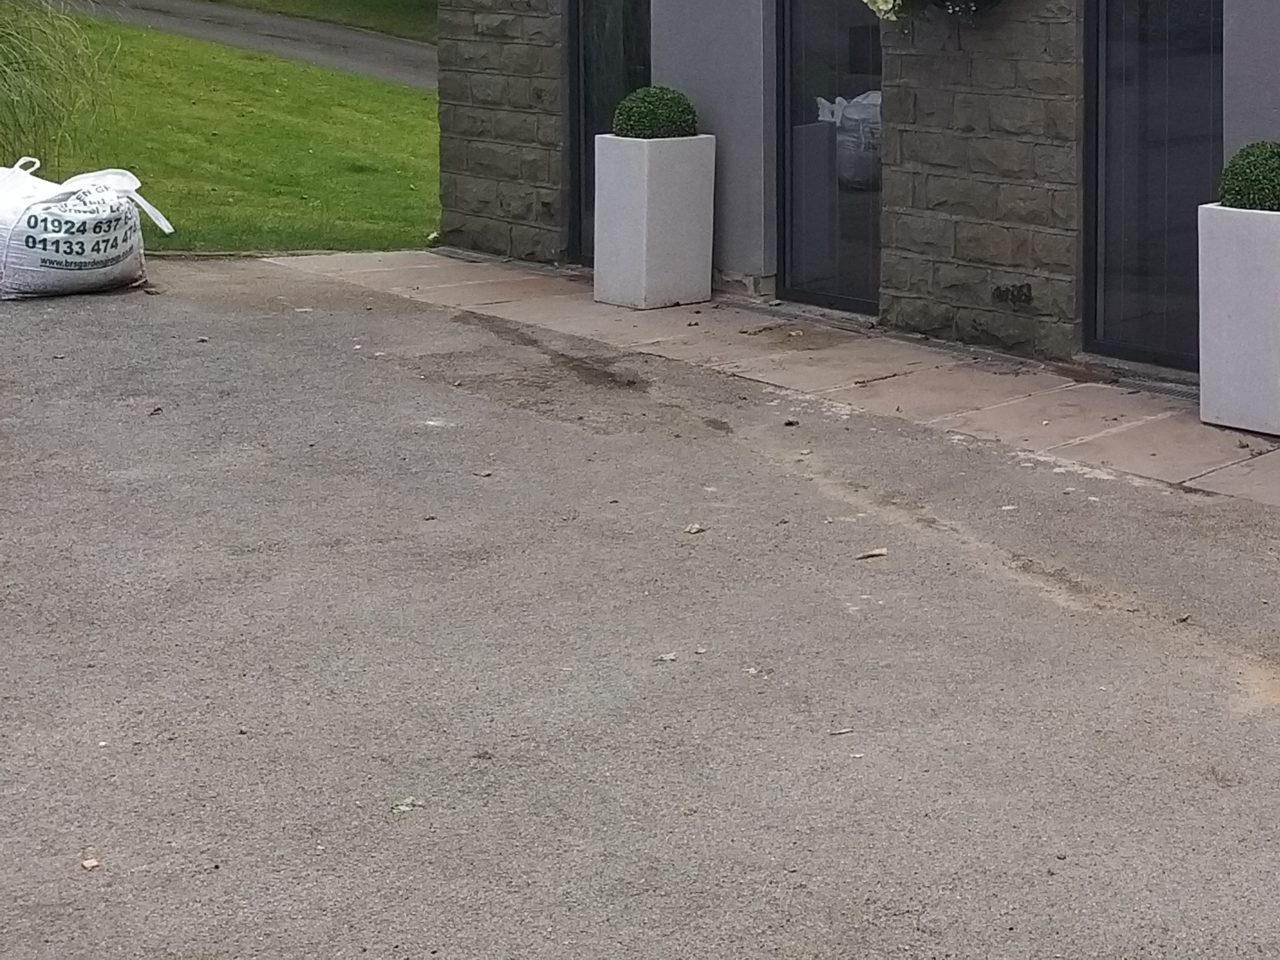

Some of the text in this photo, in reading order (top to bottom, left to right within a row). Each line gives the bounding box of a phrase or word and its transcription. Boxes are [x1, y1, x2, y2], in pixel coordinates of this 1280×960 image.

[27, 214, 121, 235] 01924 637
[25, 235, 85, 256] 01133
[91, 236, 118, 254] 474
